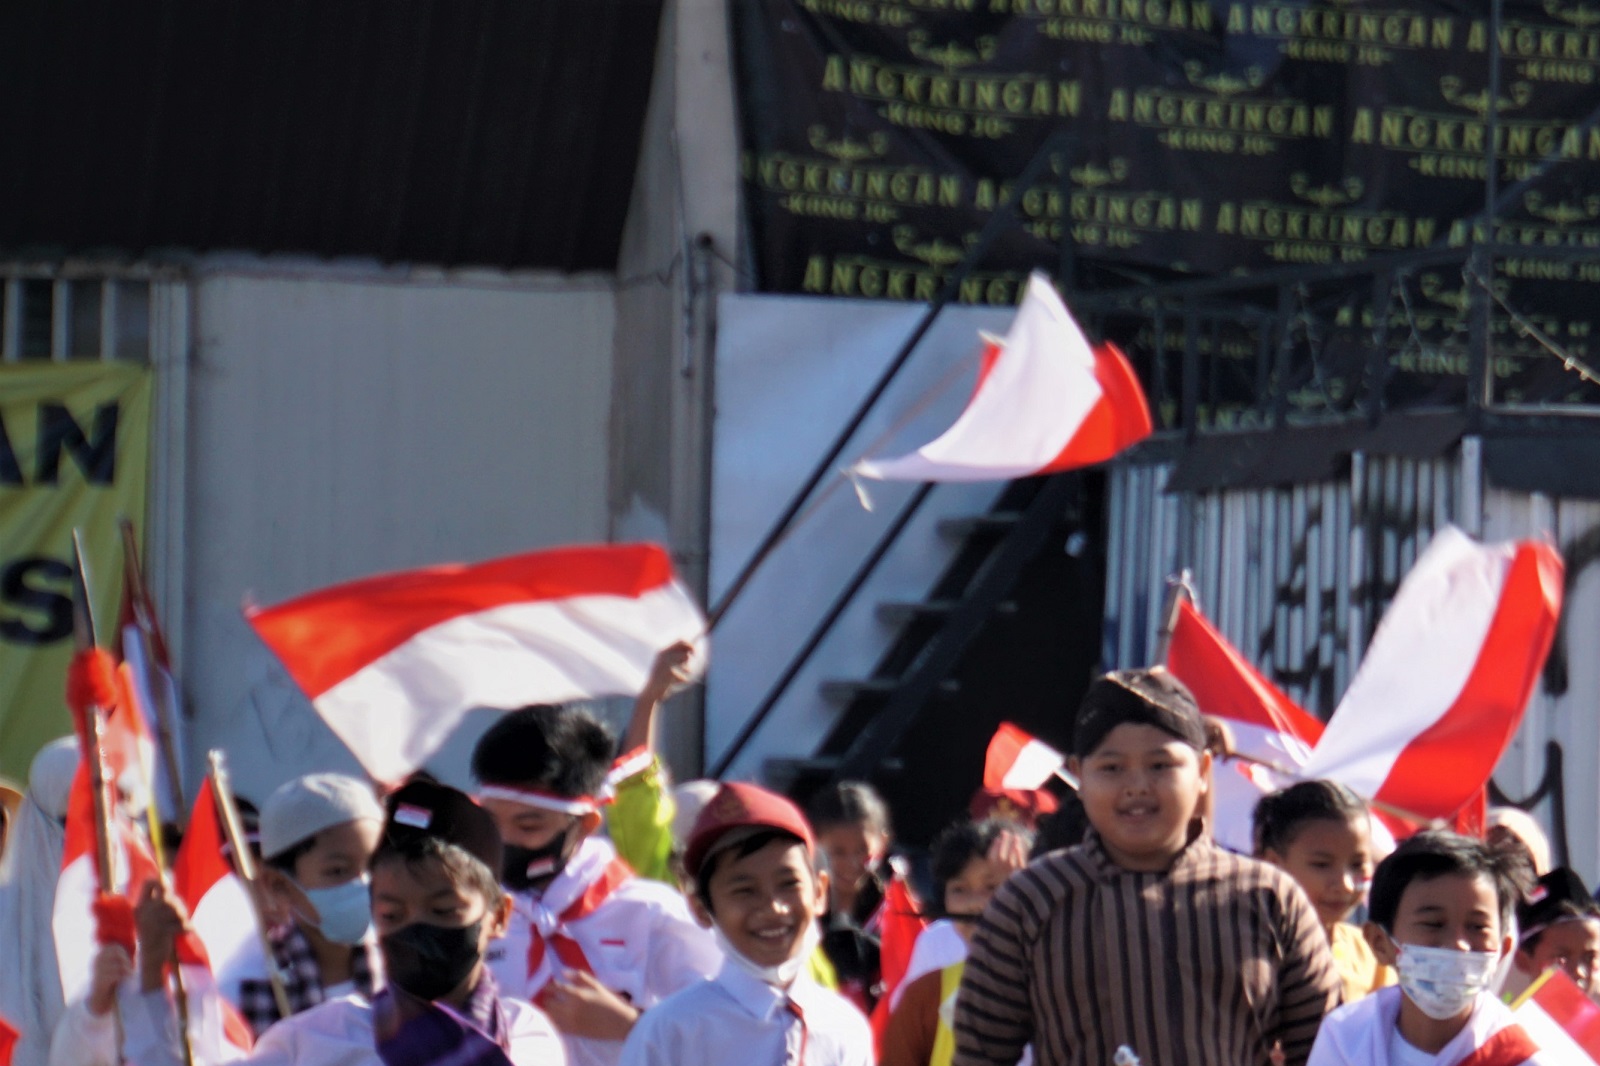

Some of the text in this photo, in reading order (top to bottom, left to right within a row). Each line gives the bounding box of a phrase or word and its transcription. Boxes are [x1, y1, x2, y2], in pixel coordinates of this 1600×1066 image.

[1227, 4, 1453, 50] ANGKRINGAN
[823, 54, 1082, 117] ANGKRINGAN
[1109, 88, 1335, 138] ANGKRINGAN
[1217, 203, 1436, 249] ANGKRINGAN
[0, 400, 119, 487] N
